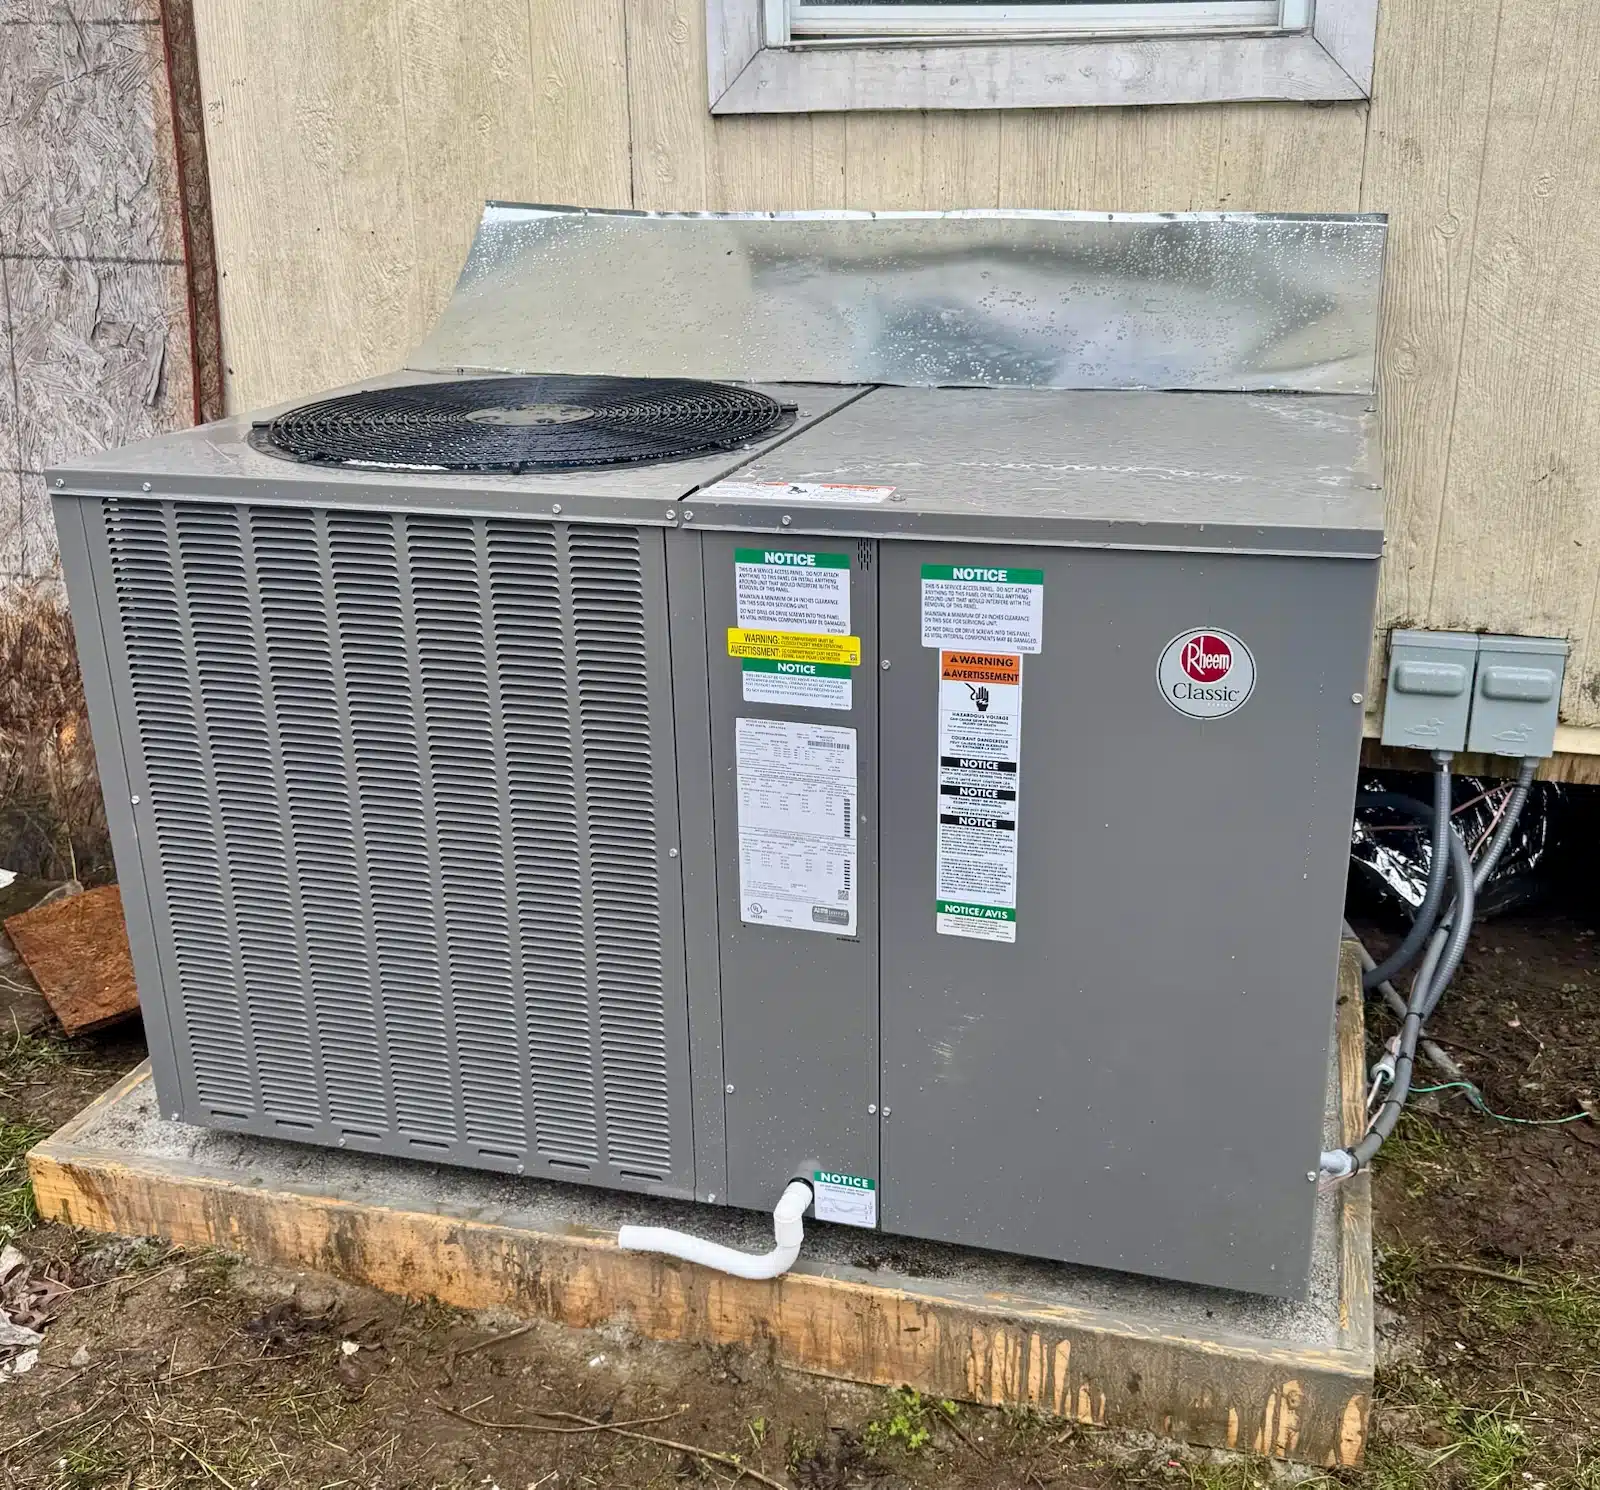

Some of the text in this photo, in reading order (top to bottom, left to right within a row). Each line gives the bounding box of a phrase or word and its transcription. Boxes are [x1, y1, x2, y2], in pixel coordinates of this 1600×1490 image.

[764, 552, 816, 566] NOTICE
[952, 568, 1008, 581] NOTICE
[744, 633, 780, 645] WARNING:
[730, 645, 780, 657] AVERTISSMENT:
[1187, 636, 1230, 675] Rheem
[960, 656, 1013, 667] WARNING
[778, 663, 816, 674] NOTICE
[952, 670, 1019, 682] AVERTISSEMENT
[1172, 683, 1237, 701] Classic
[960, 759, 999, 770] NOTICE
[960, 787, 998, 798] NOTICE
[959, 817, 998, 828] NOTICE
[821, 1172, 868, 1188] NOTICE
